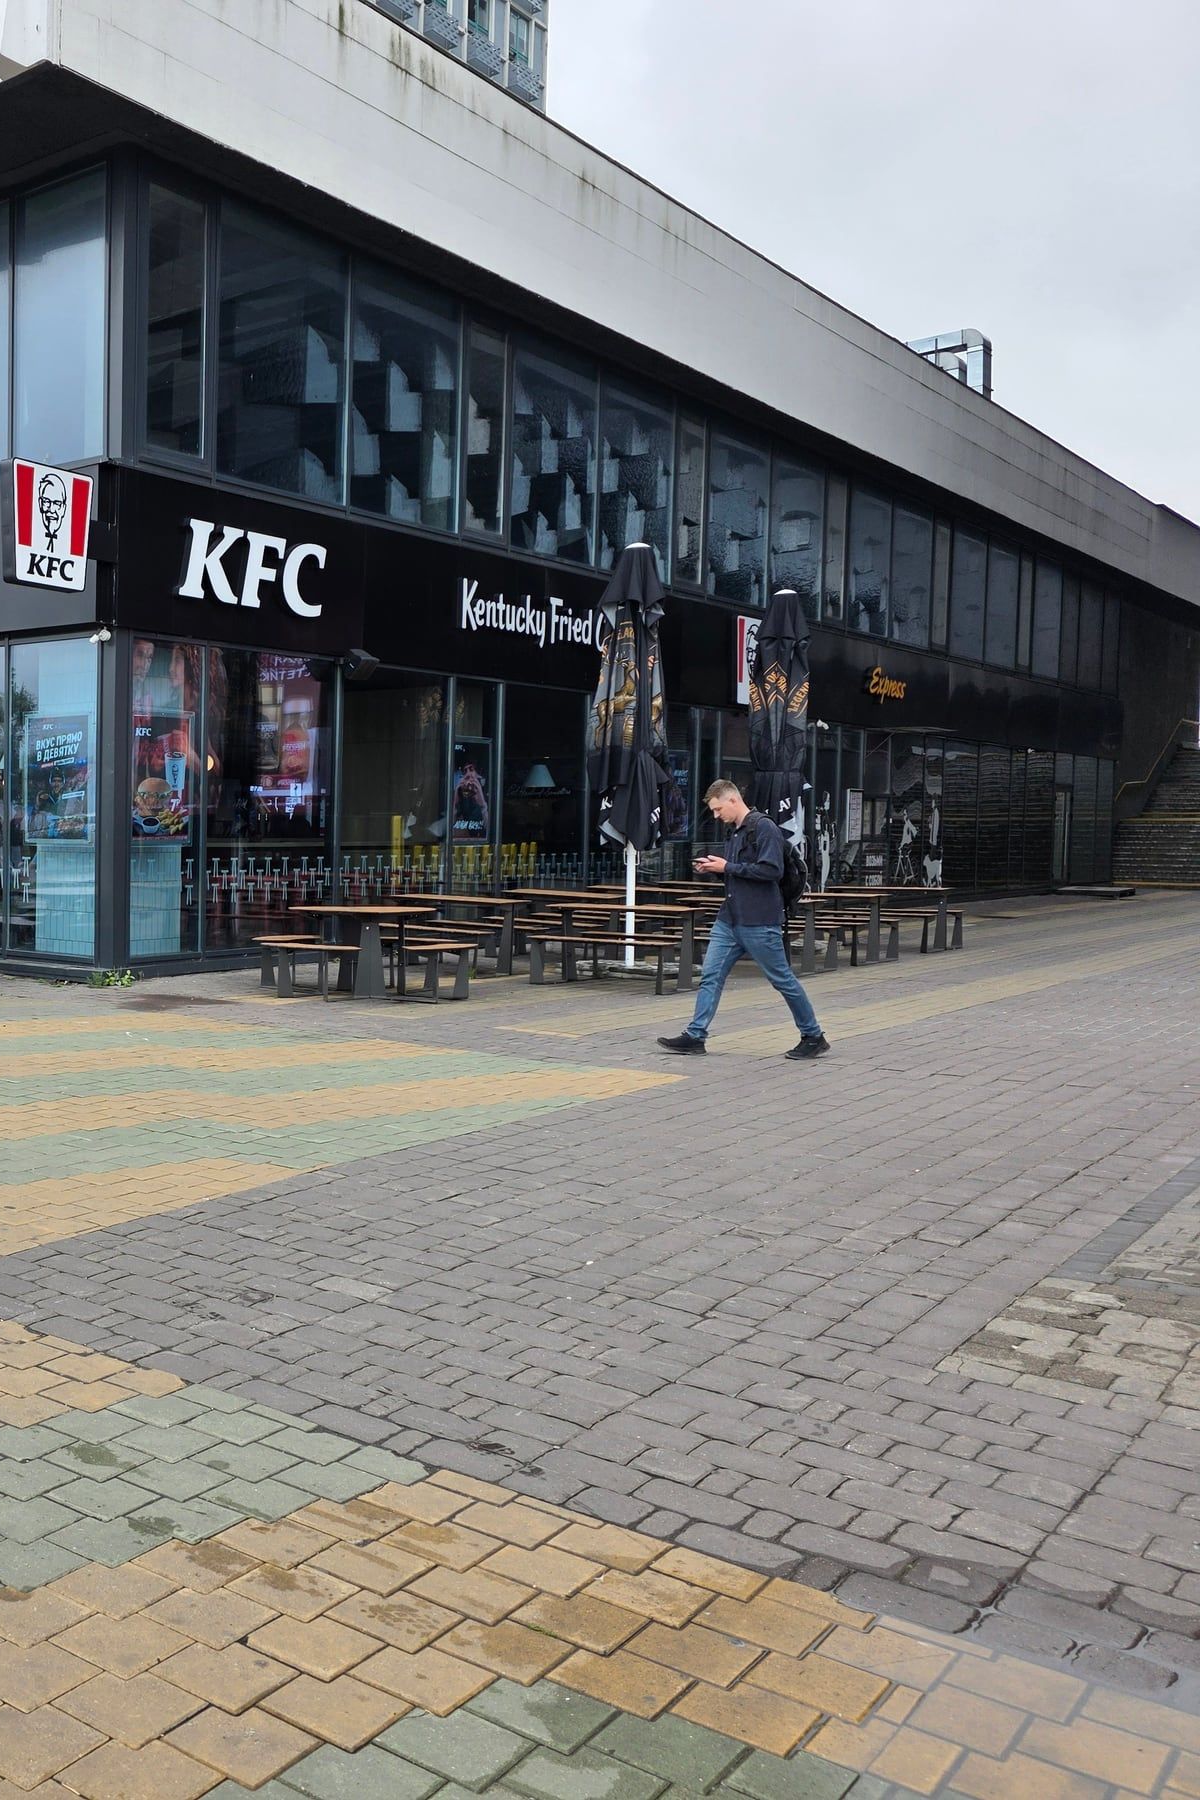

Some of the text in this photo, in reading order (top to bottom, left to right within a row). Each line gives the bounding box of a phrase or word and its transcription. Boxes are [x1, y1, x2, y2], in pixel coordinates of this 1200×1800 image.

[26, 553, 75, 582] KFC
[179, 519, 328, 618] KFC
[461, 577, 546, 649] Kentucky
[549, 596, 593, 645] Fried
[870, 665, 907, 704] Express
[36, 731, 83, 751] ВКУС ПРЯМО
[135, 727, 152, 737] KFC
[36, 743, 79, 762] В ДЕВЯТКУ
